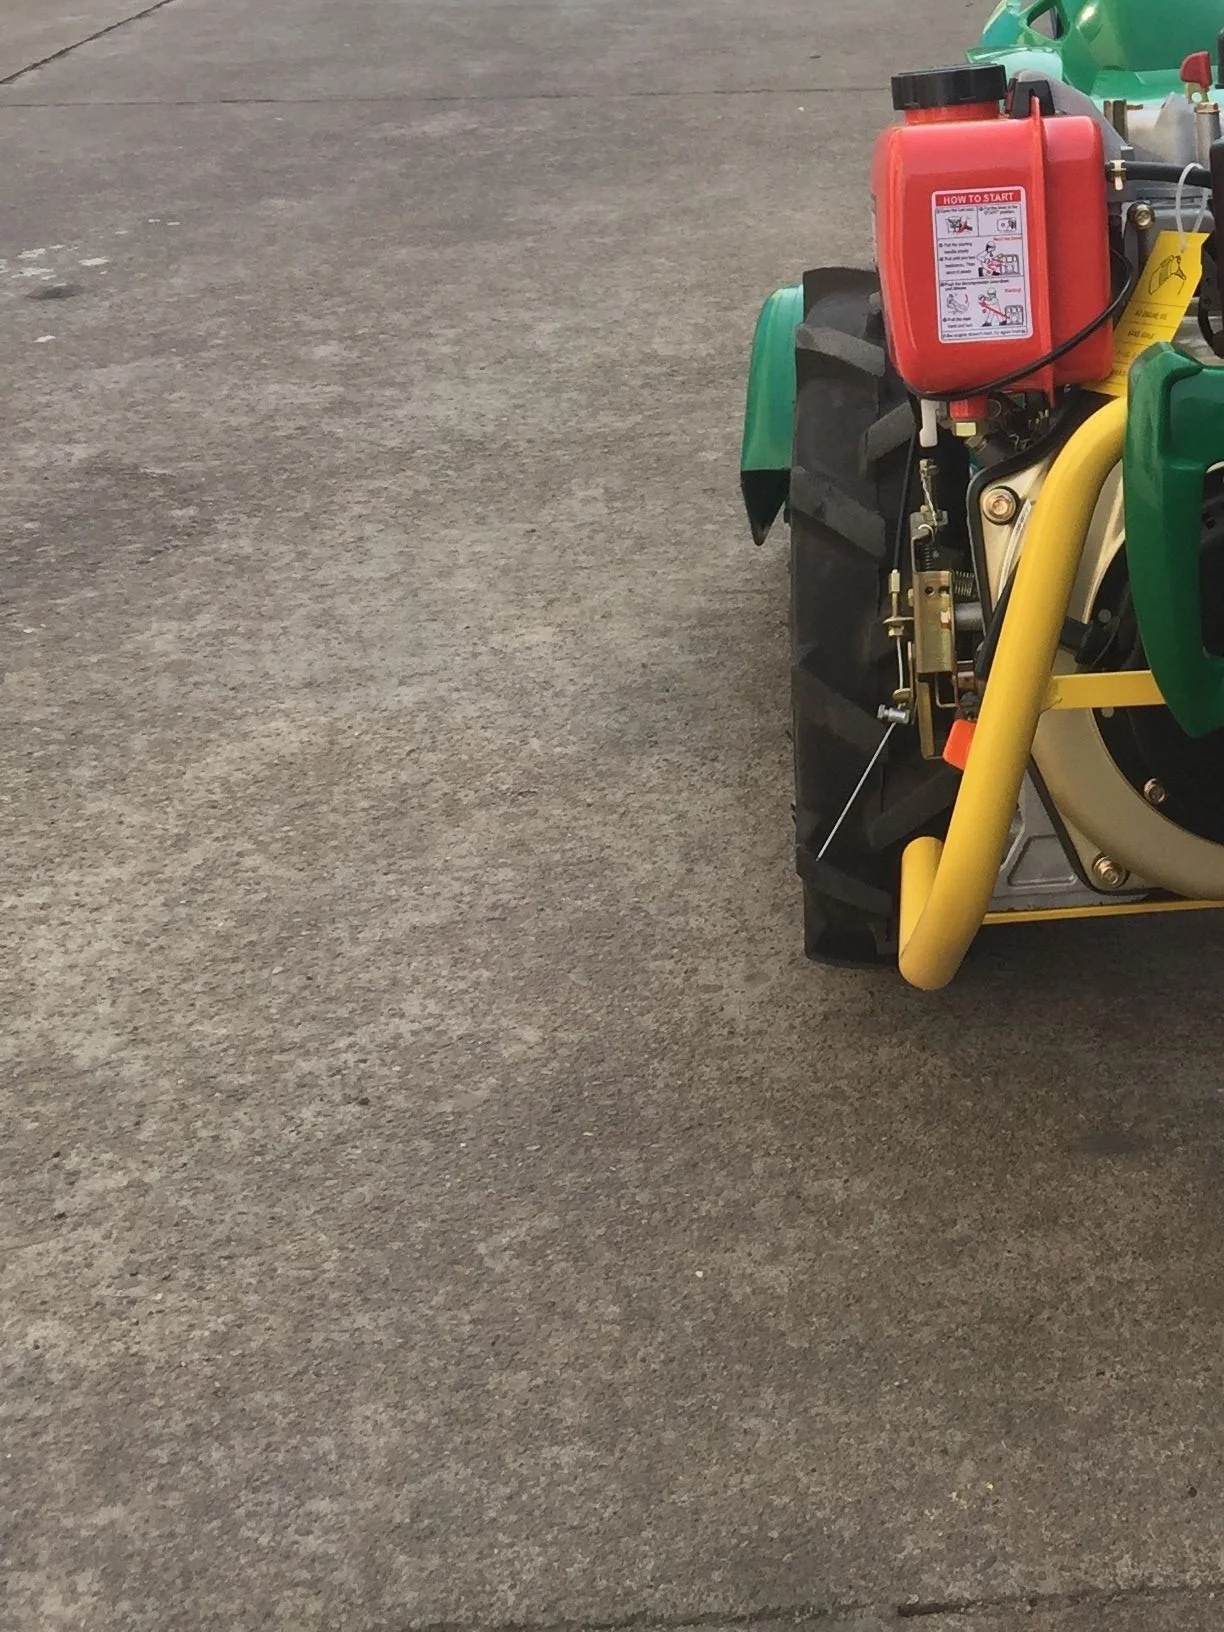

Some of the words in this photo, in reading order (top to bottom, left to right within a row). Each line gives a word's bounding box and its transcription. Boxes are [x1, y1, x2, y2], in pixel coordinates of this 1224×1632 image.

[943, 195, 967, 205] HOW
[968, 194, 982, 203] TO
[983, 192, 1014, 202] START
